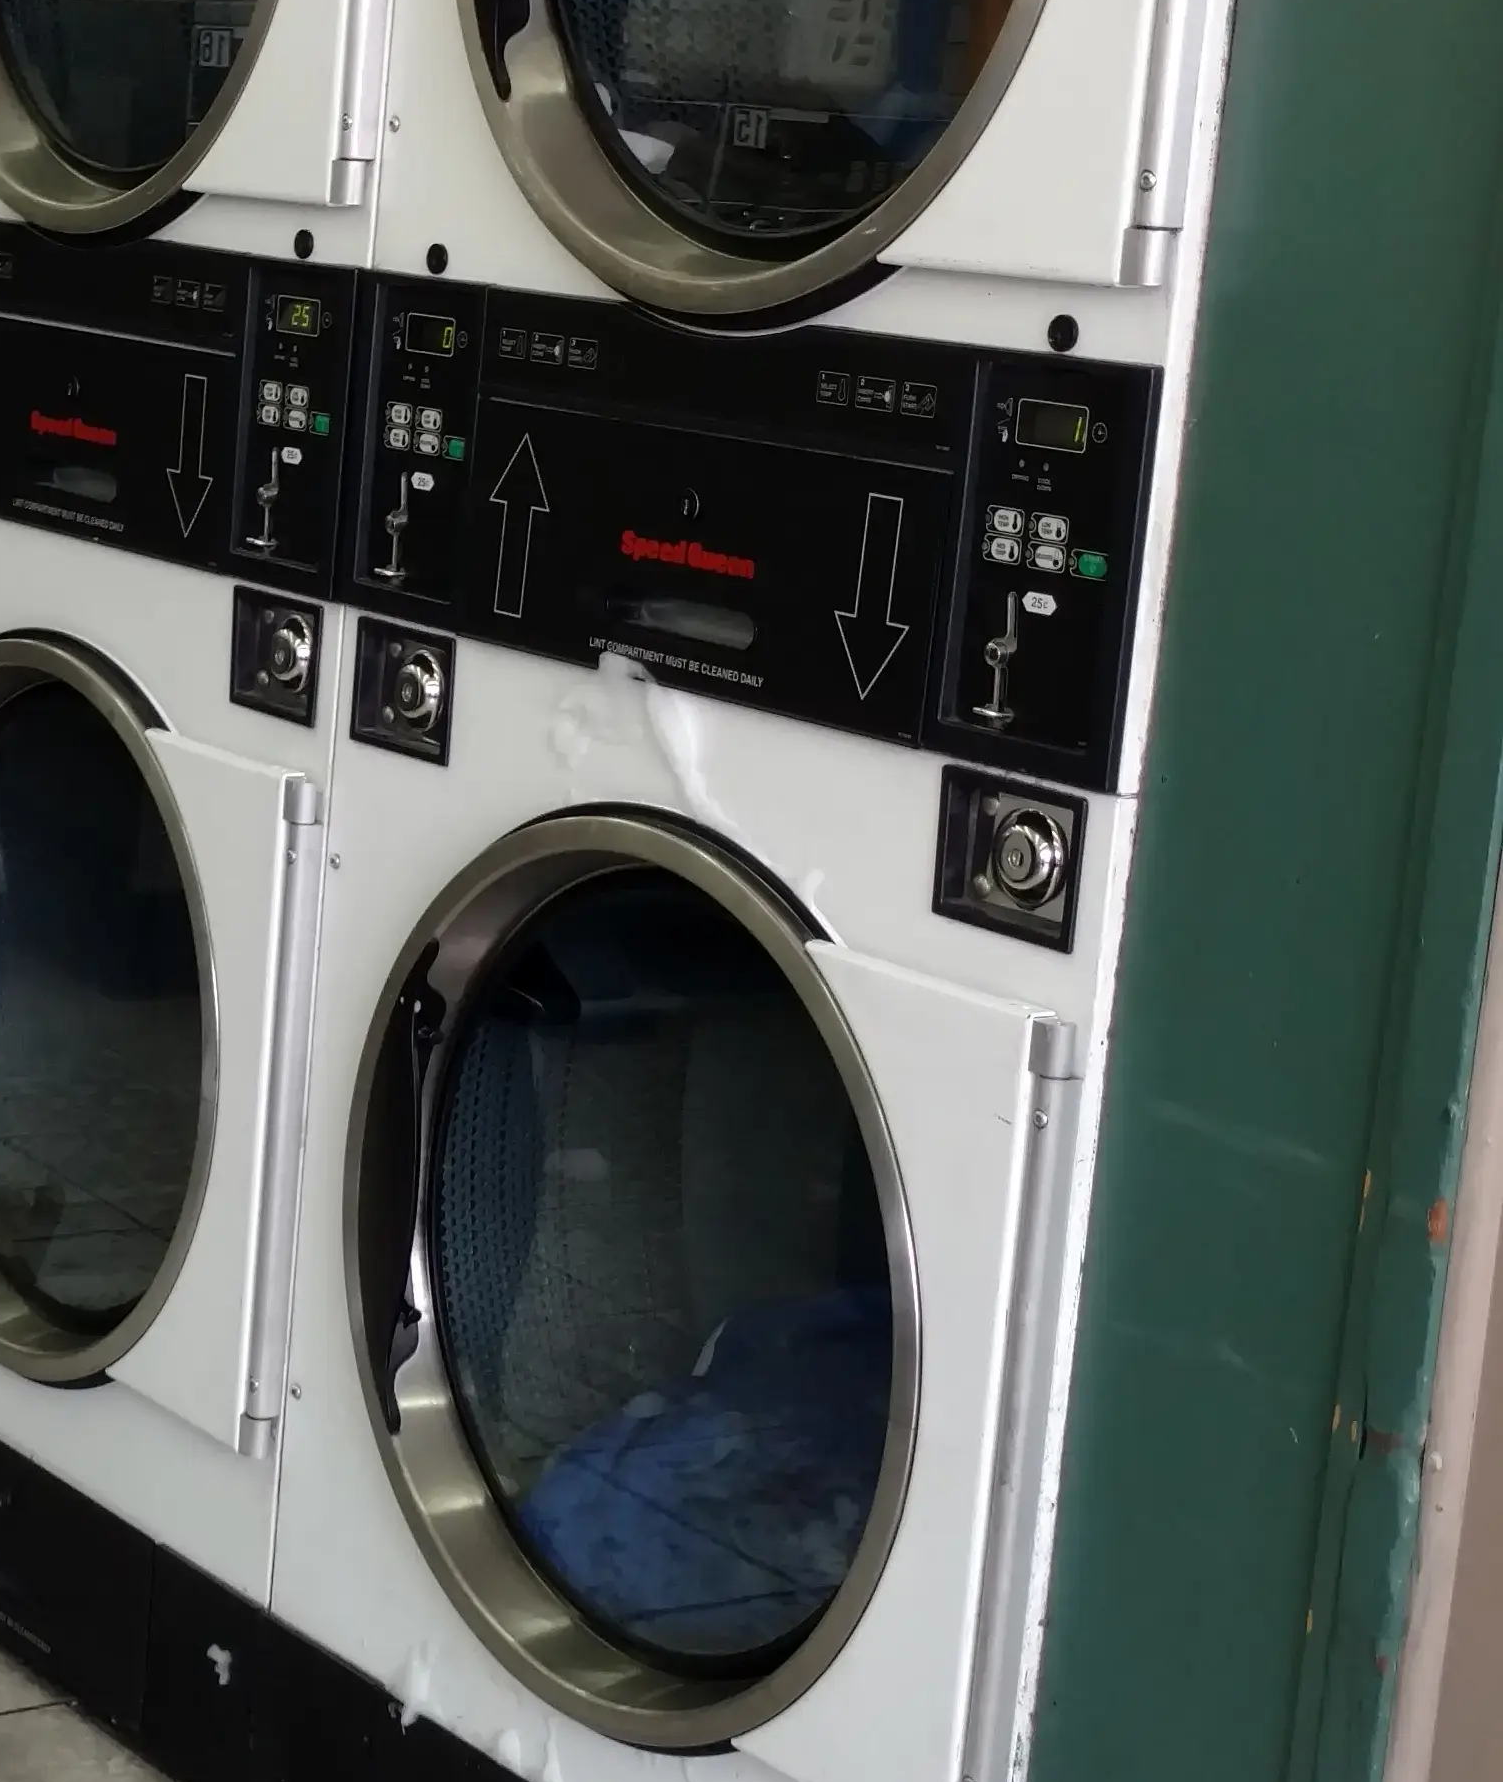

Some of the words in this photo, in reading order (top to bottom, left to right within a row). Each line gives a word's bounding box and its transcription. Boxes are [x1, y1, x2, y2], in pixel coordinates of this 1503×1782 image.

[291, 304, 311, 327] 25
[442, 326, 454, 349] 0
[1074, 416, 1084, 442] 1
[621, 530, 687, 564] Speed
[687, 541, 756, 580] Queen
[589, 635, 608, 651] LINT
[606, 640, 665, 665] COMPARTMENT
[665, 654, 687, 671] MUST
[688, 659, 700, 674] BE
[701, 662, 740, 683] CLEANED
[740, 672, 765, 689] DAILY
